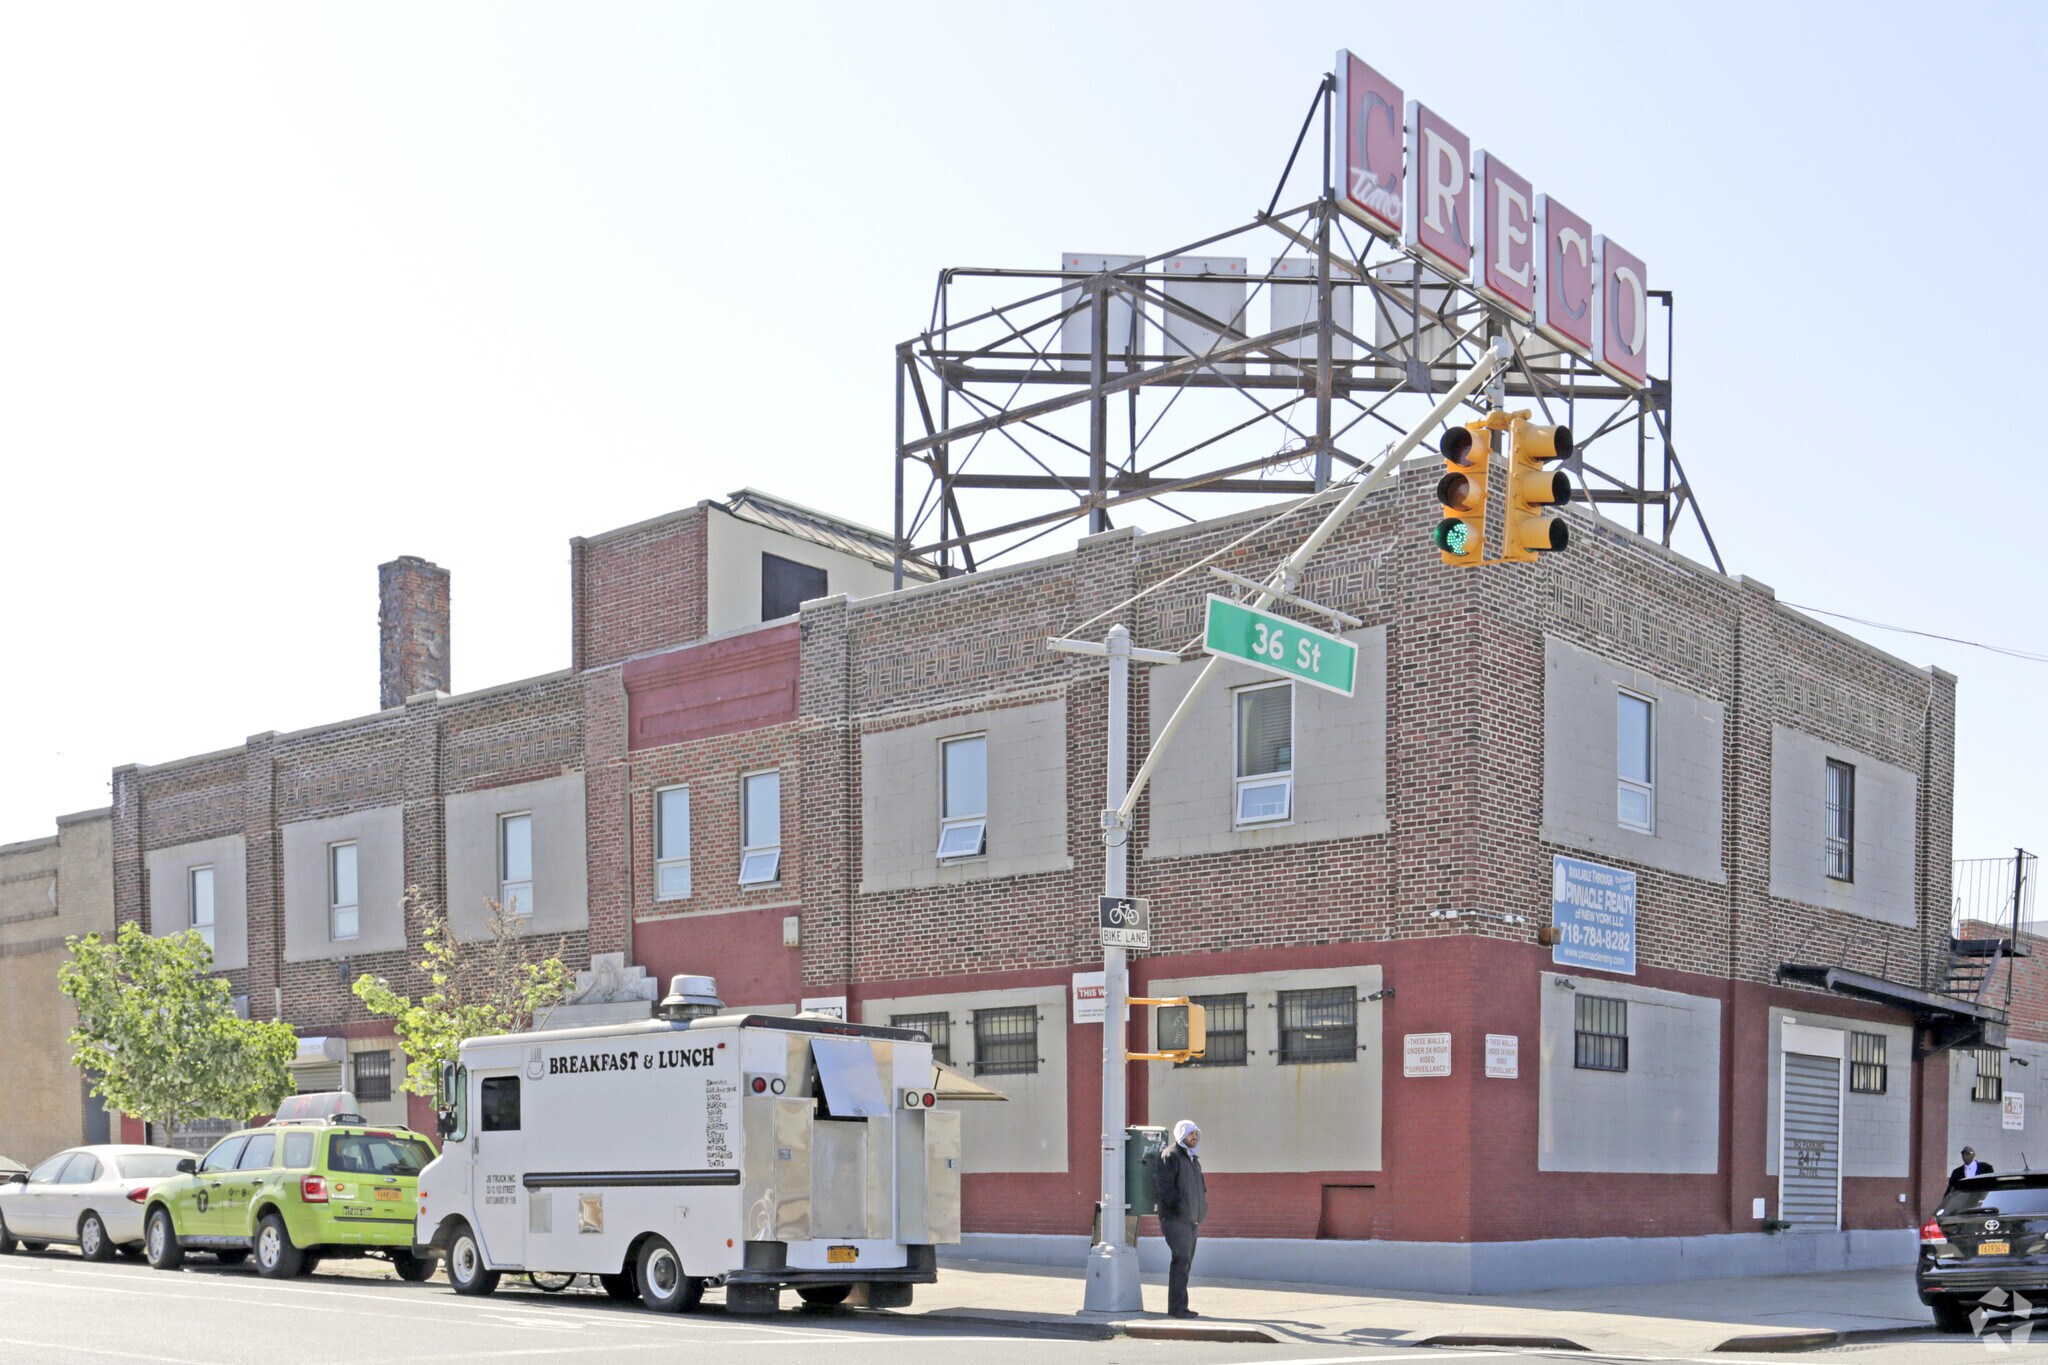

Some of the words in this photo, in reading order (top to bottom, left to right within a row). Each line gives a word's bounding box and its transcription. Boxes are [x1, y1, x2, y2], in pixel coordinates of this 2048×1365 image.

[1359, 90, 1646, 356] CRECO
[1252, 623, 1284, 660] 36
[1296, 638, 1322, 673] St
[1566, 880, 1604, 910] PINNACLE
[1605, 890, 1633, 916] REALTY
[1582, 910, 1595, 922] NEW
[1595, 912, 1612, 925] YORK
[1612, 915, 1624, 928] LLC
[1104, 930, 1121, 942] BIKE
[1126, 931, 1146, 944] LANE
[1560, 922, 1630, 952] 718-784-8282
[1079, 988, 1097, 998] THIS
[1490, 1038, 1501, 1046] THESE
[1433, 1046, 1448, 1054] HOUR
[550, 1052, 638, 1074] BREAKFAST
[644, 1054, 654, 1069] &
[658, 1047, 714, 1068] LUNCH
[1420, 1056, 1435, 1064] VIDEO
[1488, 1066, 1515, 1074] SURVEILLANCE
[1798, 1151, 1820, 1166] 24/7
[492, 1174, 506, 1182] TRUCK
[508, 1174, 516, 1182] INC.
[503, 1185, 516, 1193] STREET
